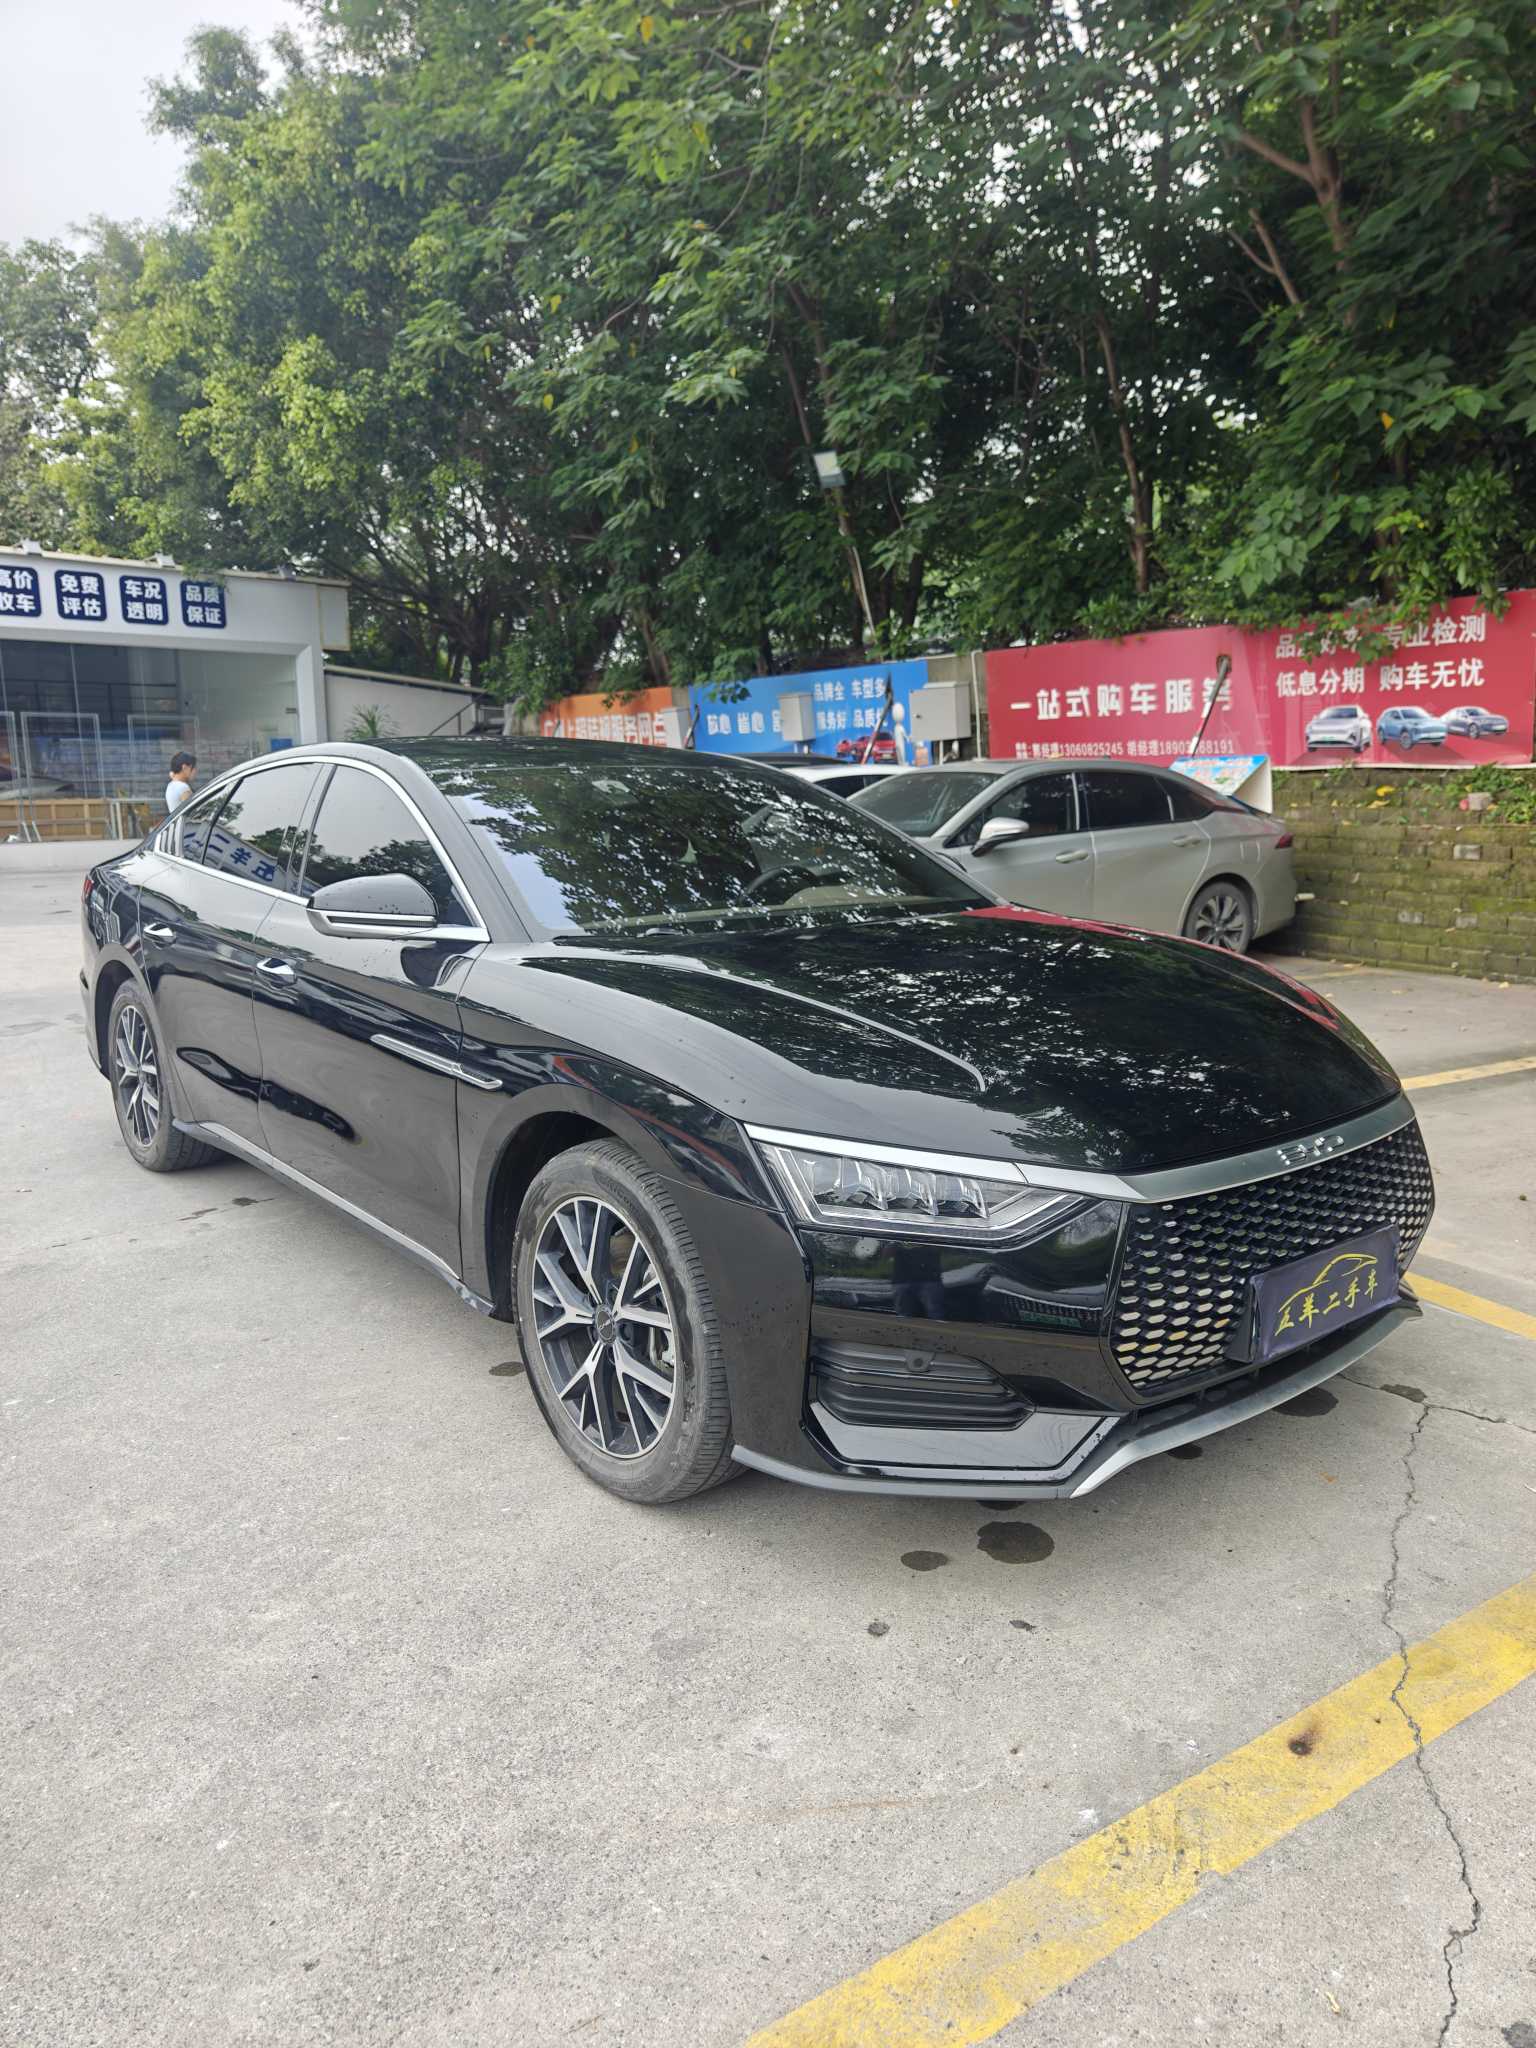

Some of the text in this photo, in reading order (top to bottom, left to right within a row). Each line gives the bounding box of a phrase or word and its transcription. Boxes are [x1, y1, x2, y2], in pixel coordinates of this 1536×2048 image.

[59, 573, 100, 596] 免费
[124, 578, 162, 600] 车况
[185, 584, 221, 604] 品质
[62, 596, 102, 617] 评估
[126, 601, 164, 622] 透明
[186, 605, 222, 625] 保证
[1383, 612, 1486, 650] 专业检测
[851, 677, 887, 700] 车型多
[1276, 657, 1486, 698] 低息分期 购车无忧
[1010, 677, 1233, 720] 一站式购车服务
[1276, 1135, 1345, 1166] BYD
